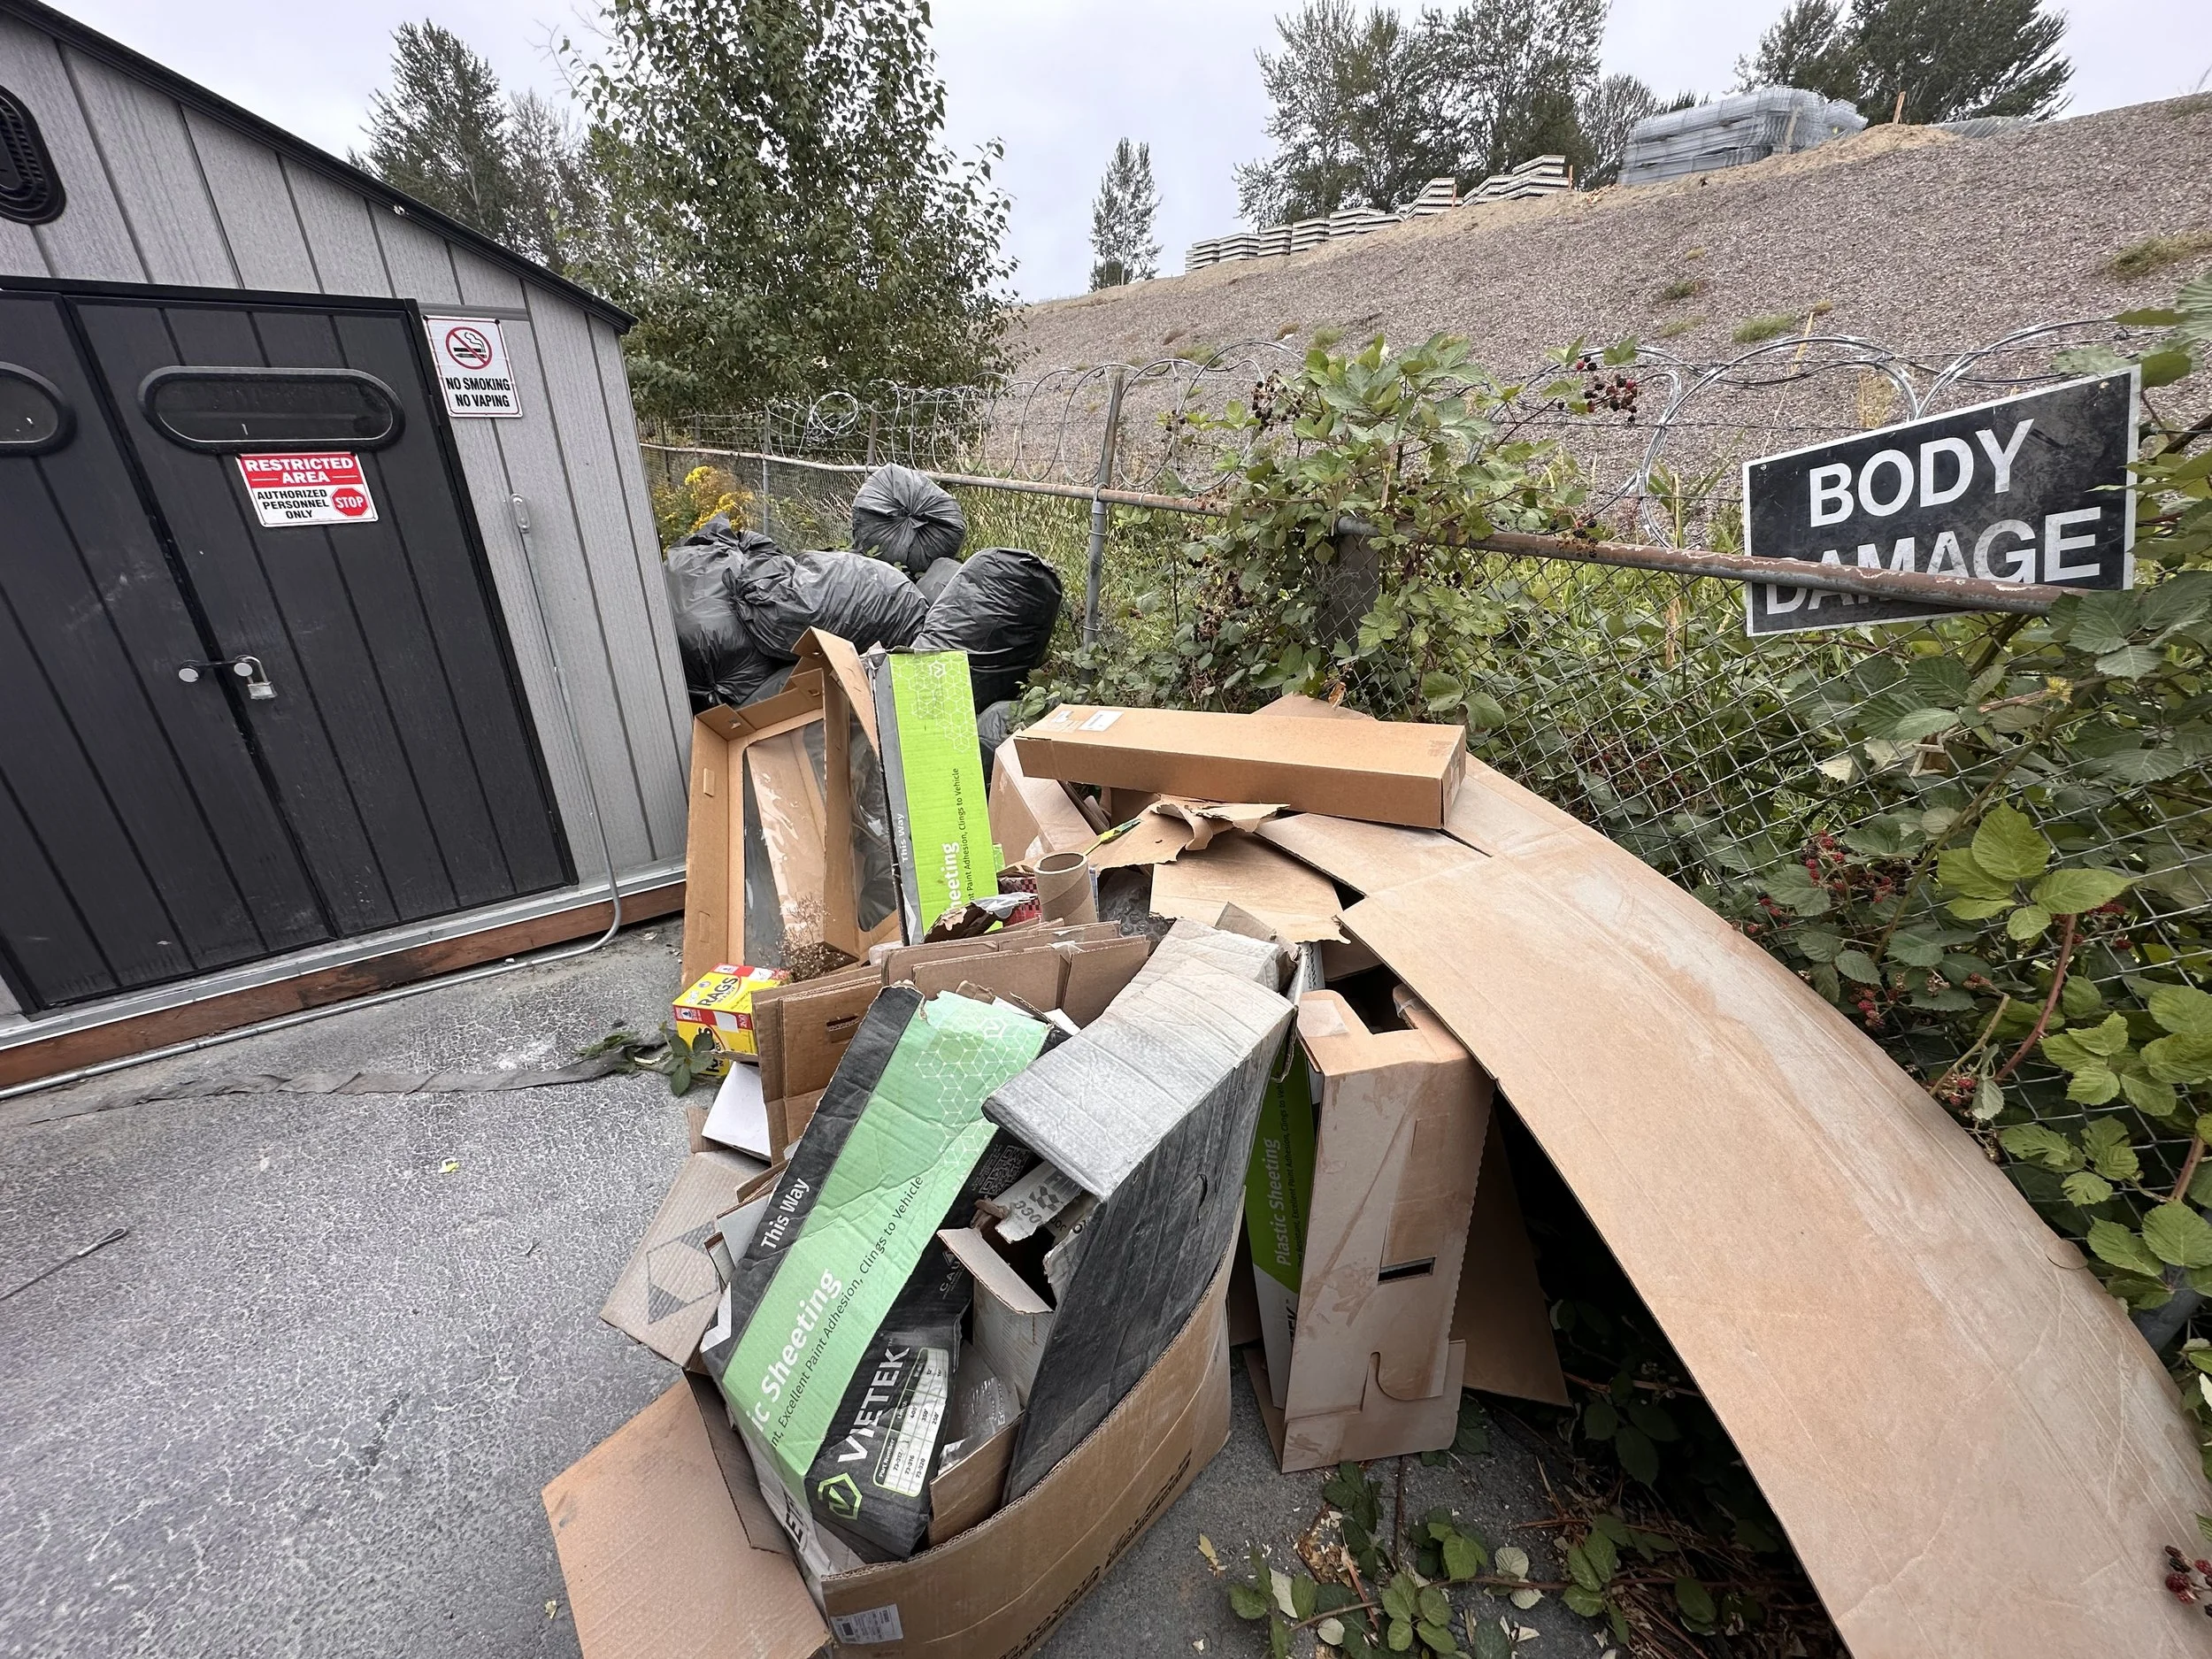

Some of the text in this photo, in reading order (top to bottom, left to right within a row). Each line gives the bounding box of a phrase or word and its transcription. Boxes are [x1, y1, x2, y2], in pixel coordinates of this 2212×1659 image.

[445, 377, 511, 391] NO SMOKING
[455, 394, 511, 407] NO VAPING
[243, 457, 354, 472] RESTRICTED
[1809, 419, 2034, 527] BODY
[282, 471, 331, 484] AREA
[257, 488, 328, 501] AUTHORIZED
[263, 499, 330, 511] PERSONNEL
[334, 495, 364, 509] STOP
[285, 510, 313, 519] ONLY
[953, 768, 962, 795] Vehicle
[956, 795, 963, 806] to
[958, 806, 968, 831] Clings
[960, 832, 972, 871] Adhesion,
[941, 841, 962, 913] heeting
[965, 871, 974, 893] Paint
[697, 977, 738, 1007] RAGS
[739, 1014, 748, 1028] 200
[760, 1178, 810, 1250] This Way
[1263, 1138, 1291, 1266] Plastic Sheeting
[939, 1259, 962, 1293] CAU
[771, 1176, 924, 1448] nt, Excellent Paint Adhesion, Clings to Vehicle
[750, 1269, 843, 1432] ic Sheeting
[838, 1348, 910, 1463] VIETEK
